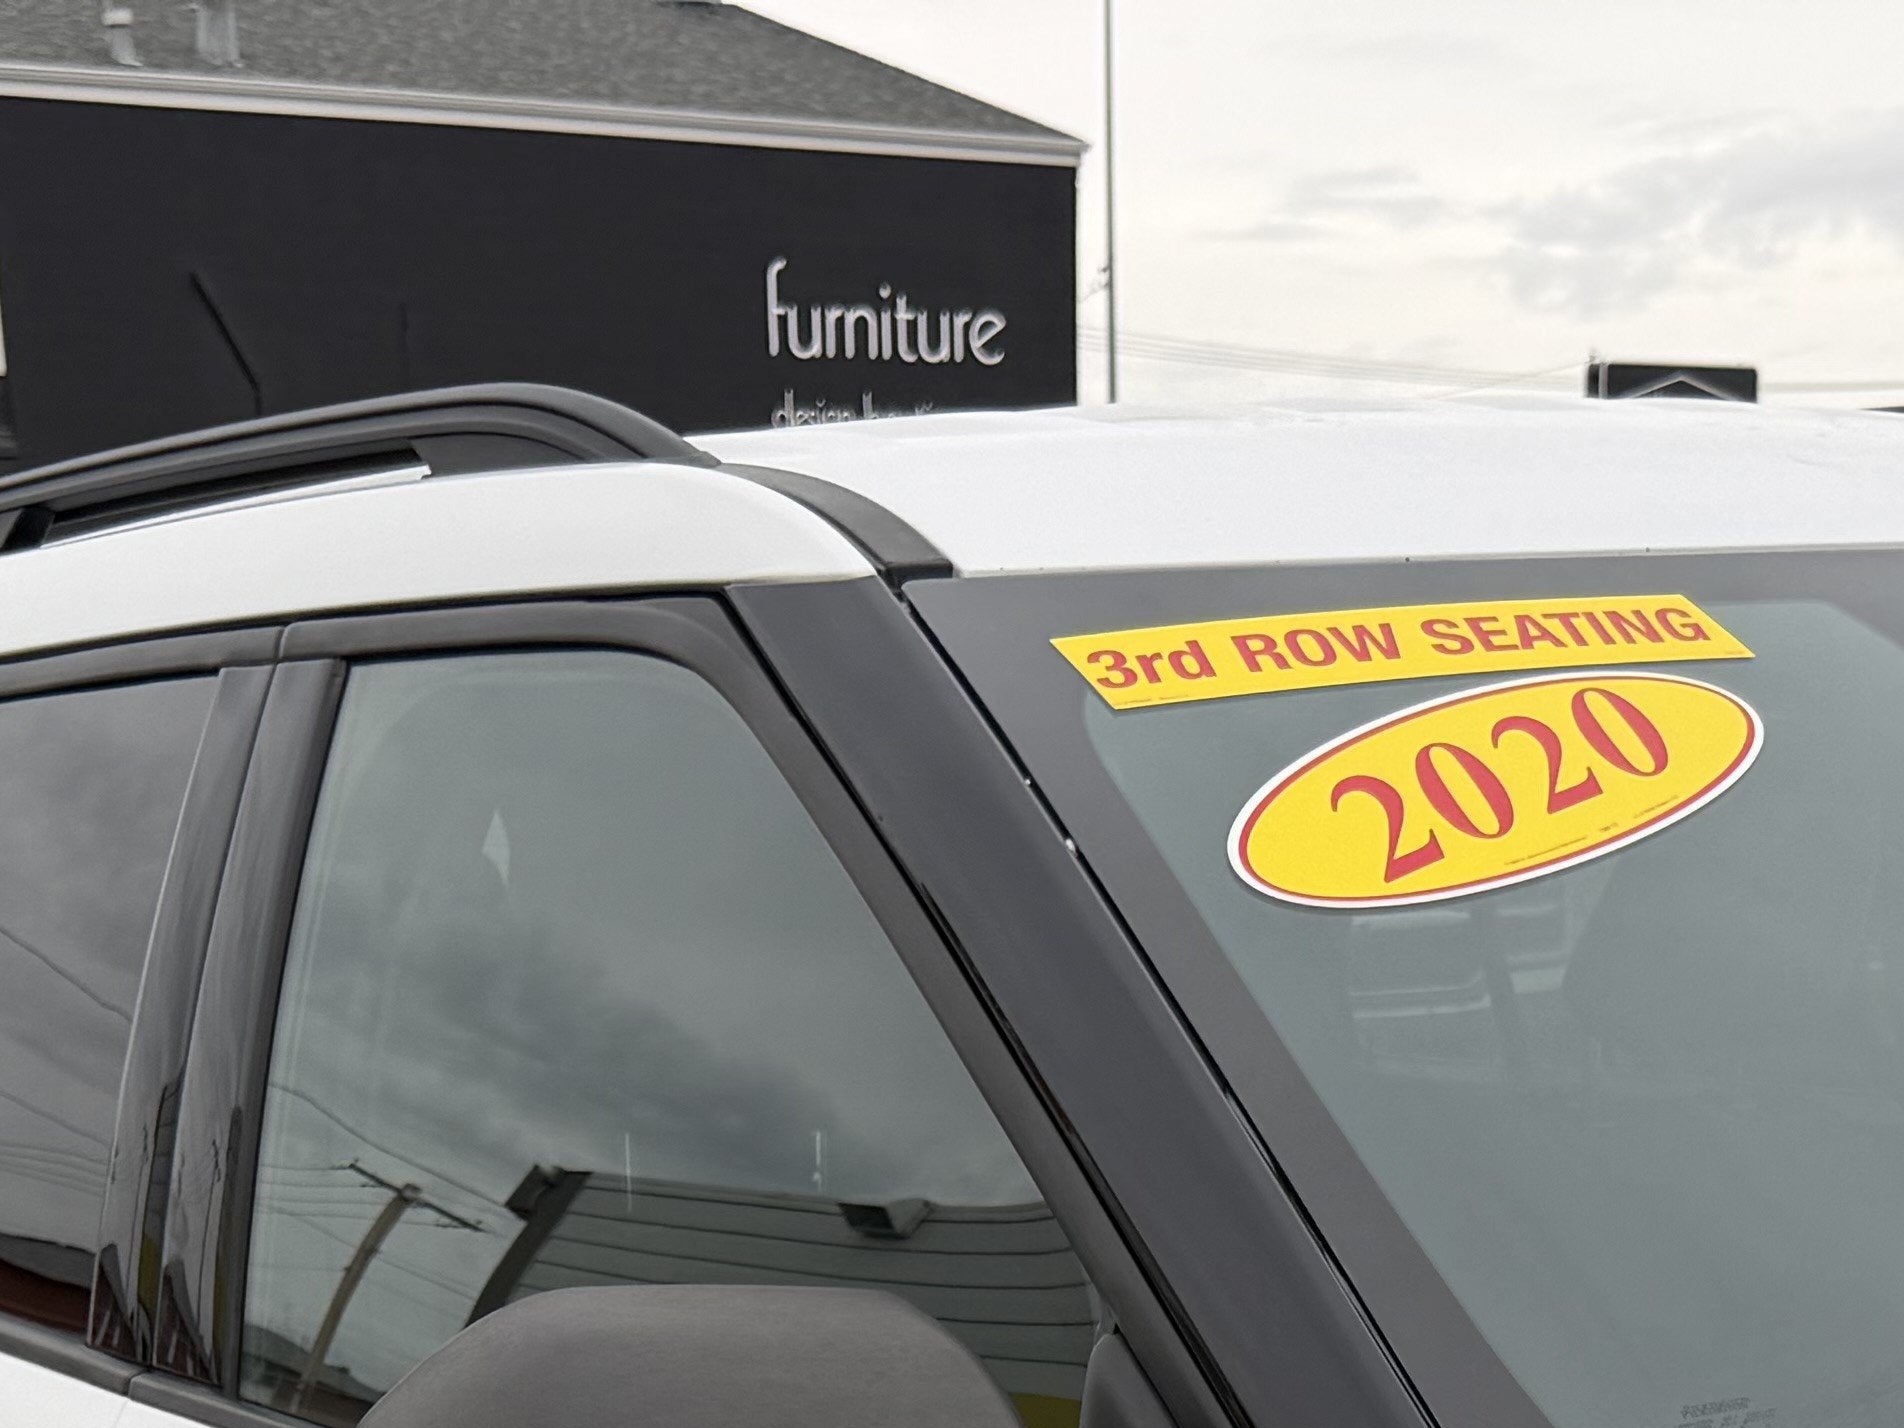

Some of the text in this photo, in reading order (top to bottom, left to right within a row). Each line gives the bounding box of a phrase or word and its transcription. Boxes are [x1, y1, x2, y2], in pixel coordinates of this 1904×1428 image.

[766, 257, 1007, 366] furniture
[1087, 608, 1709, 689] 3rd ROW SEATING
[1330, 687, 1669, 884] 2020
